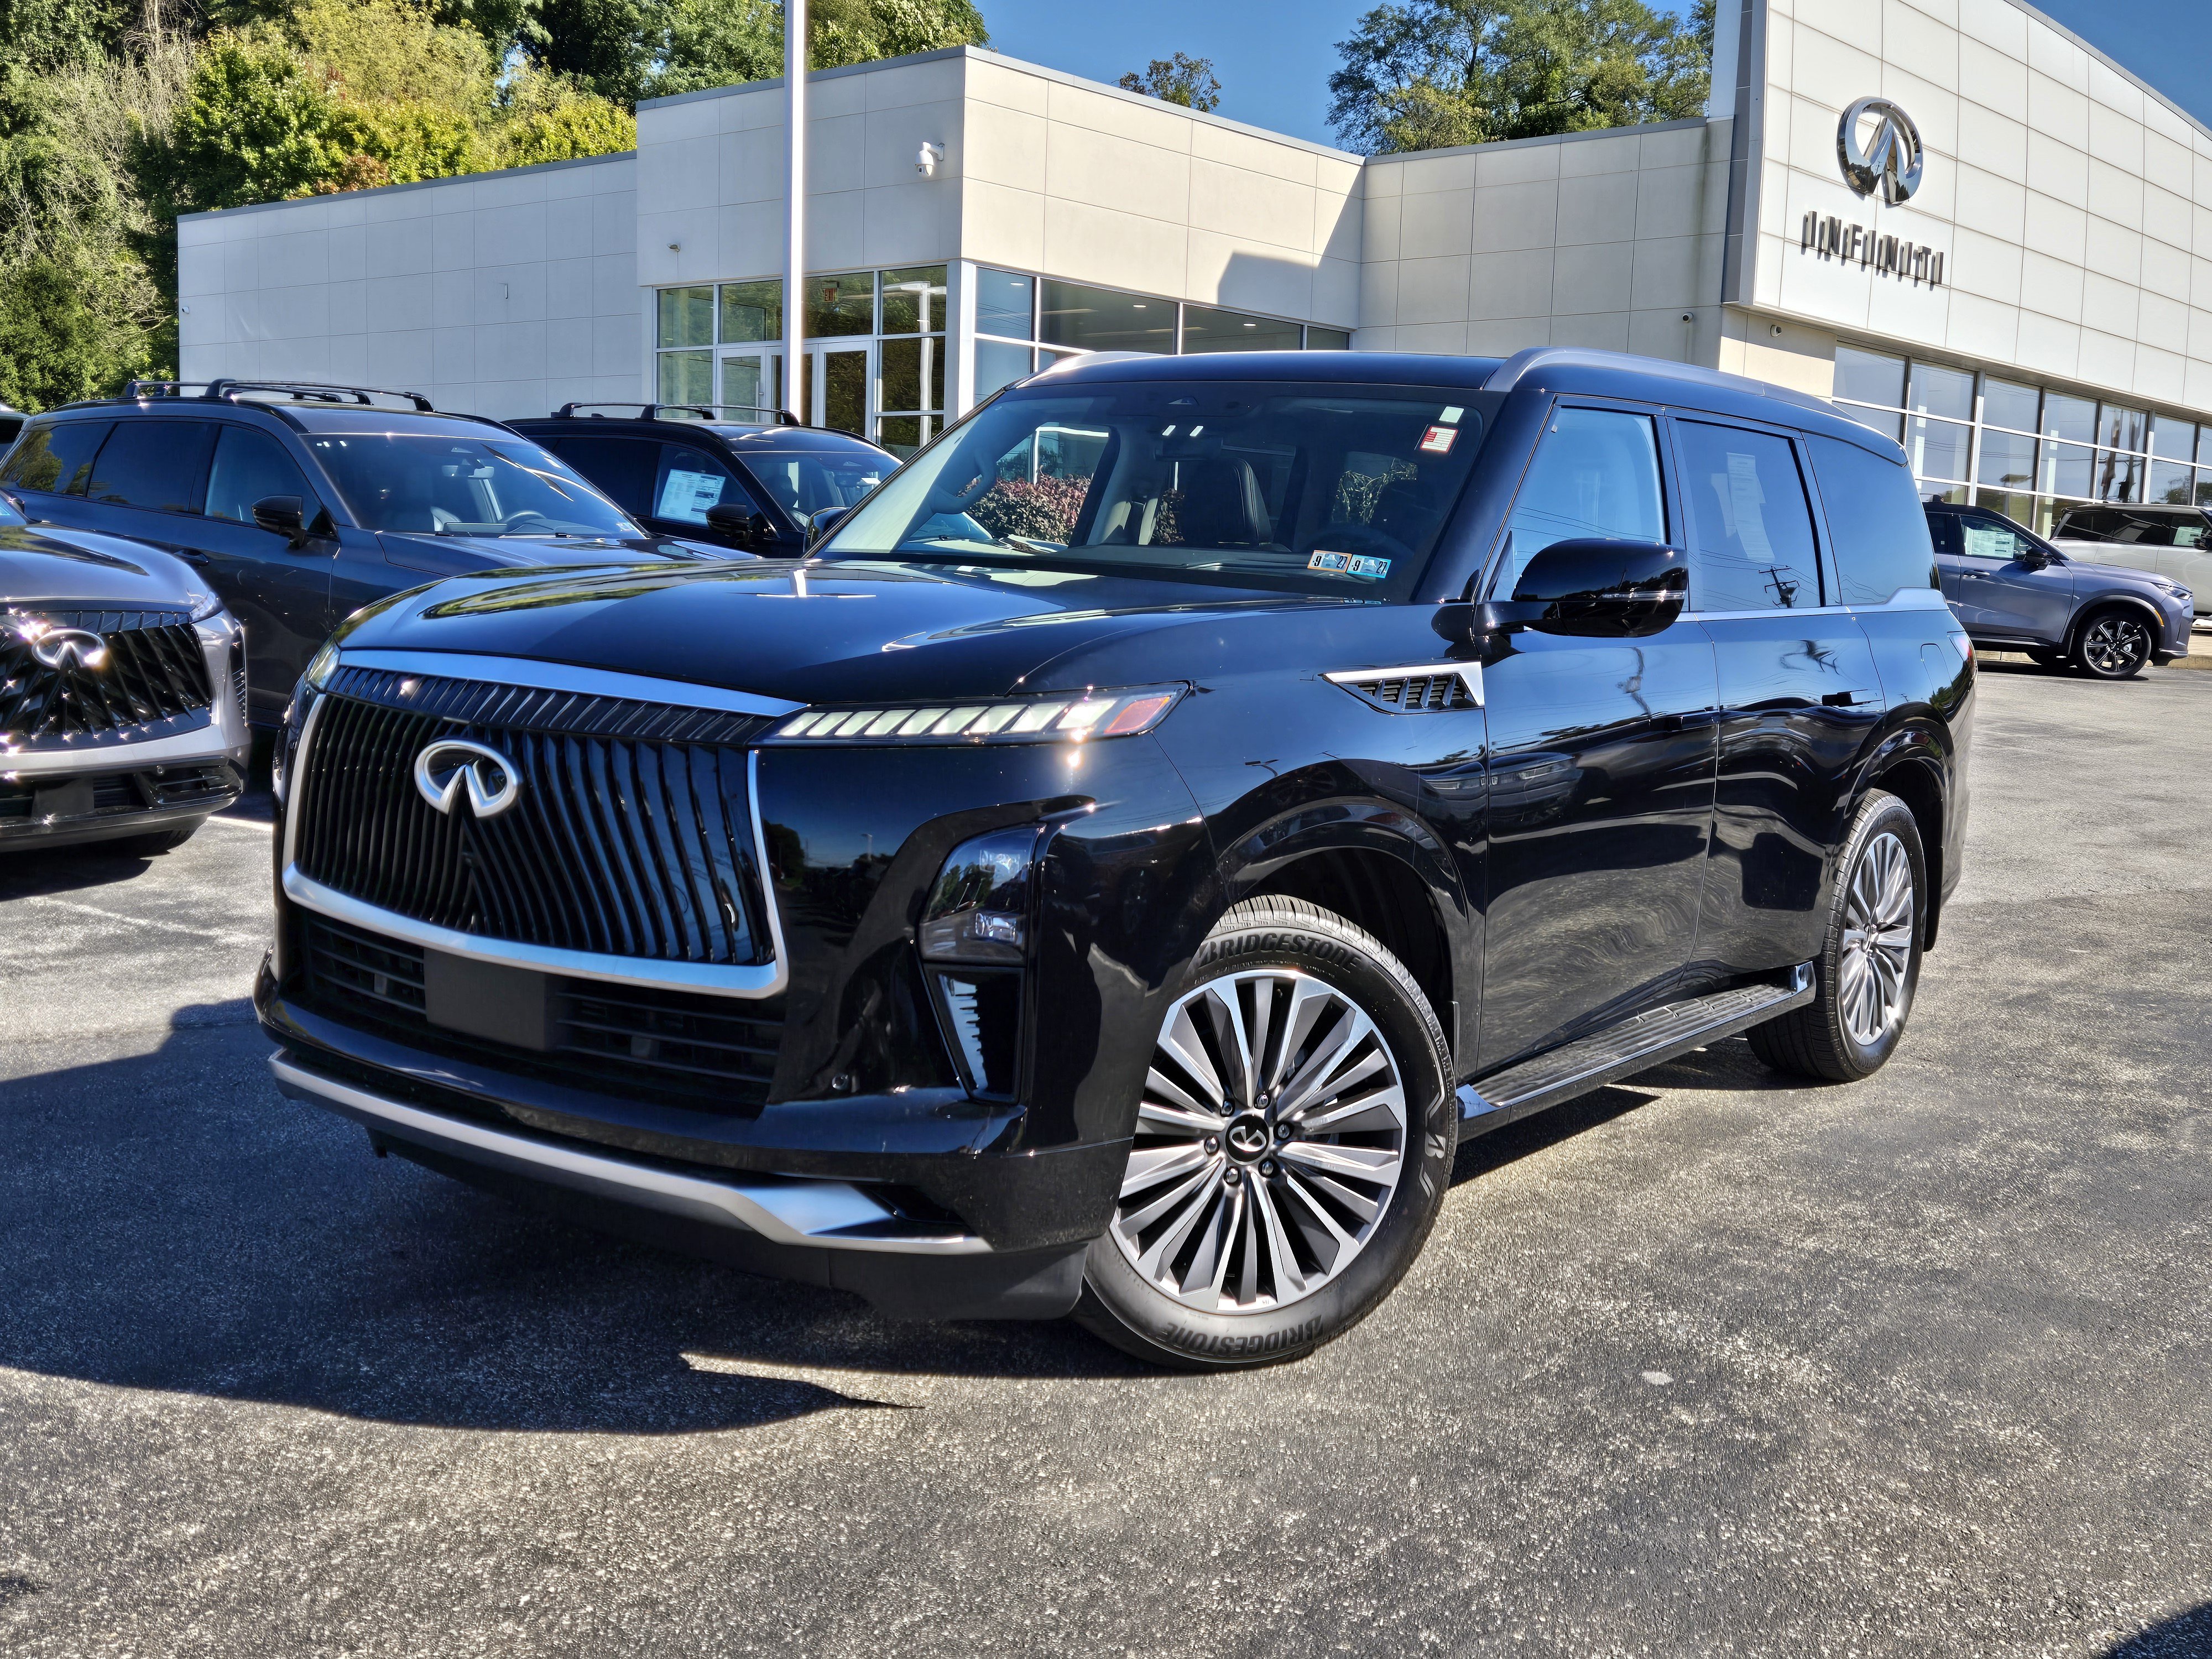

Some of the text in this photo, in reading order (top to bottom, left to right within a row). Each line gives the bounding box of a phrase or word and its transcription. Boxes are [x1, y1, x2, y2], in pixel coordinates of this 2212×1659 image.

[1806, 211, 1944, 285] INFINITI
[1314, 556, 1348, 568] 9 27
[1353, 560, 1388, 574] 9 27
[1198, 933, 1361, 973] BRIDGESTONE
[1154, 1314, 1324, 1355] BRIDGESTONE
